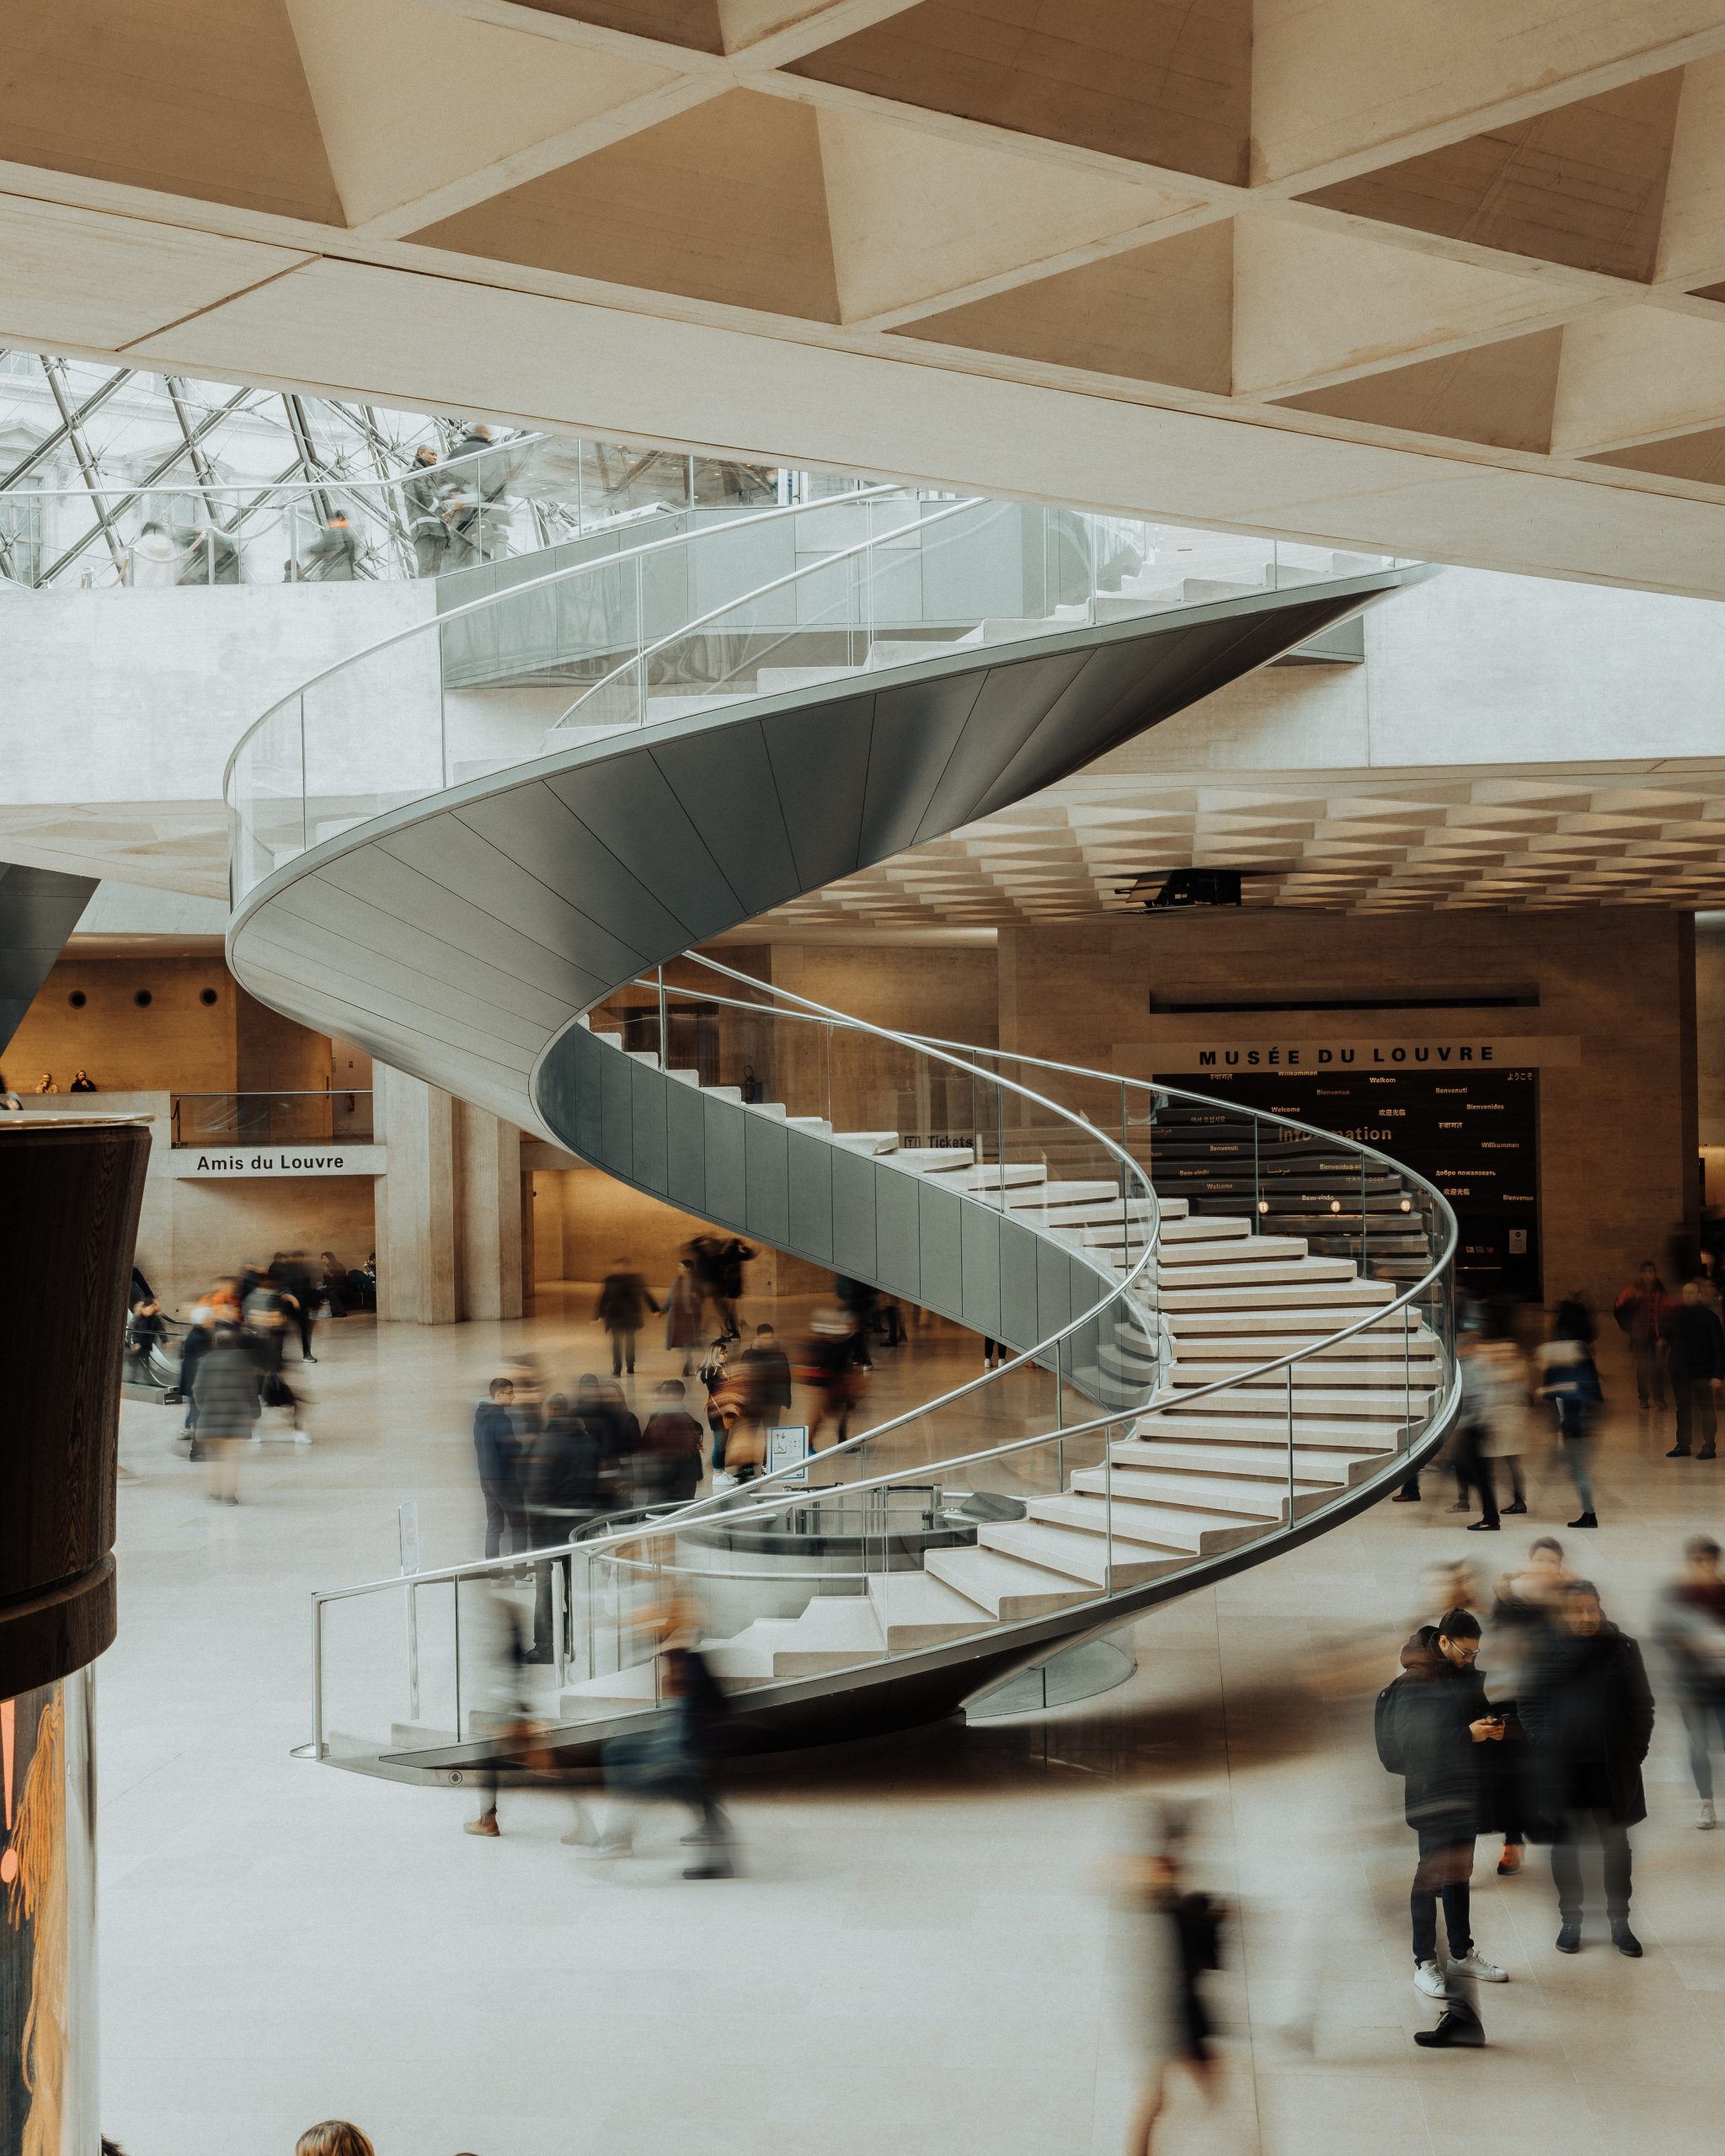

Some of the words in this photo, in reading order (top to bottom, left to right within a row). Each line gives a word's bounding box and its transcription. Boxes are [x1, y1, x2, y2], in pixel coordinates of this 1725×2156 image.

[1199, 1047, 1300, 1065] MUSÉE
[1318, 1049, 1355, 1064] DU
[1373, 1046, 1493, 1063] LOUVRE
[1507, 1072, 1534, 1081] ようこそ
[927, 1135, 974, 1148] Tickets
[196, 1155, 244, 1171] Amis
[250, 1155, 273, 1170] du
[280, 1155, 344, 1169] Louvre
